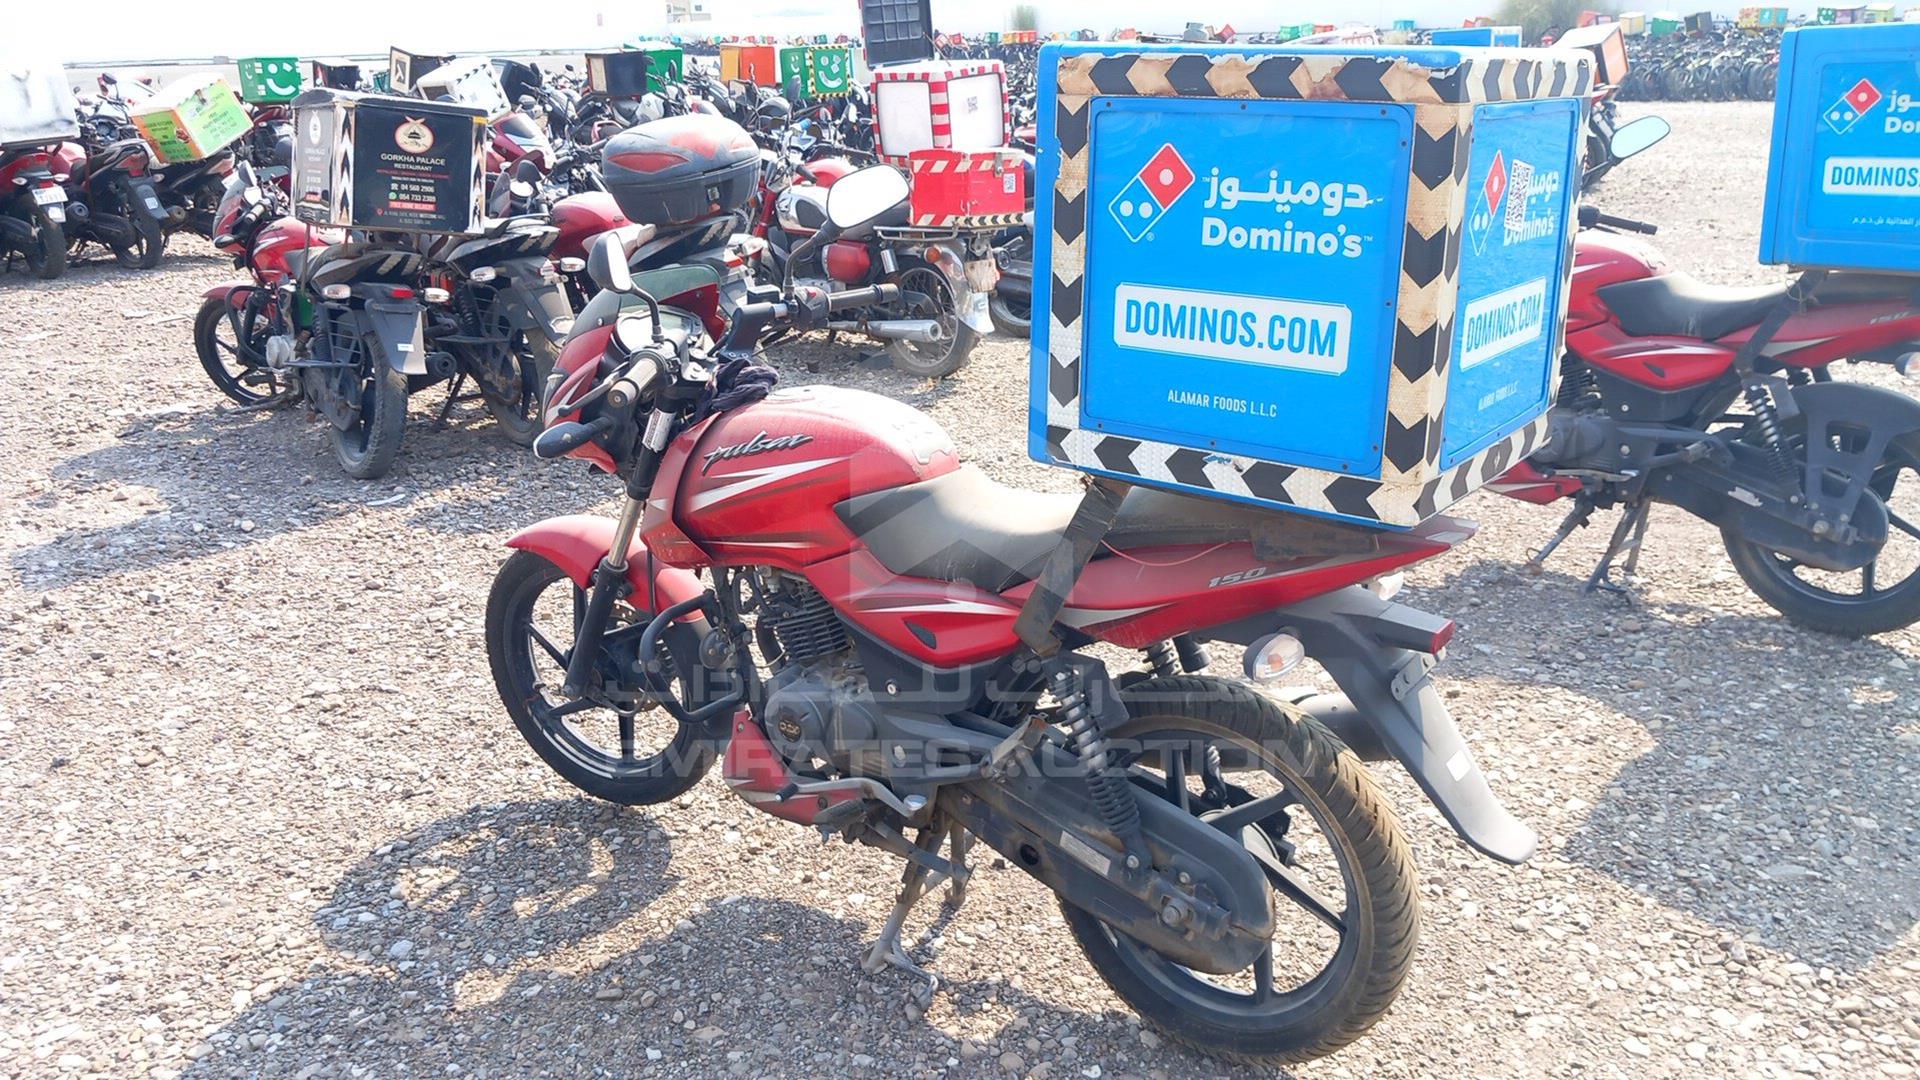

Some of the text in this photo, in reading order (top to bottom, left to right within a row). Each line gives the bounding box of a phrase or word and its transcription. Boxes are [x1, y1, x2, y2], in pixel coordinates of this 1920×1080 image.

[381, 153, 445, 166] GORKHA PALACE
[394, 163, 432, 171] RESTAURANT
[1203, 167, 1370, 217] دومينوز
[1201, 216, 1363, 258] Domino's
[1125, 299, 1337, 357] DOMINOS.COM
[1466, 292, 1542, 353] DOMINOS.COM
[1168, 389, 1277, 418] ALAMAR FOODS L.L.C
[702, 430, 814, 477] pulsar
[1208, 567, 1267, 588] 150
